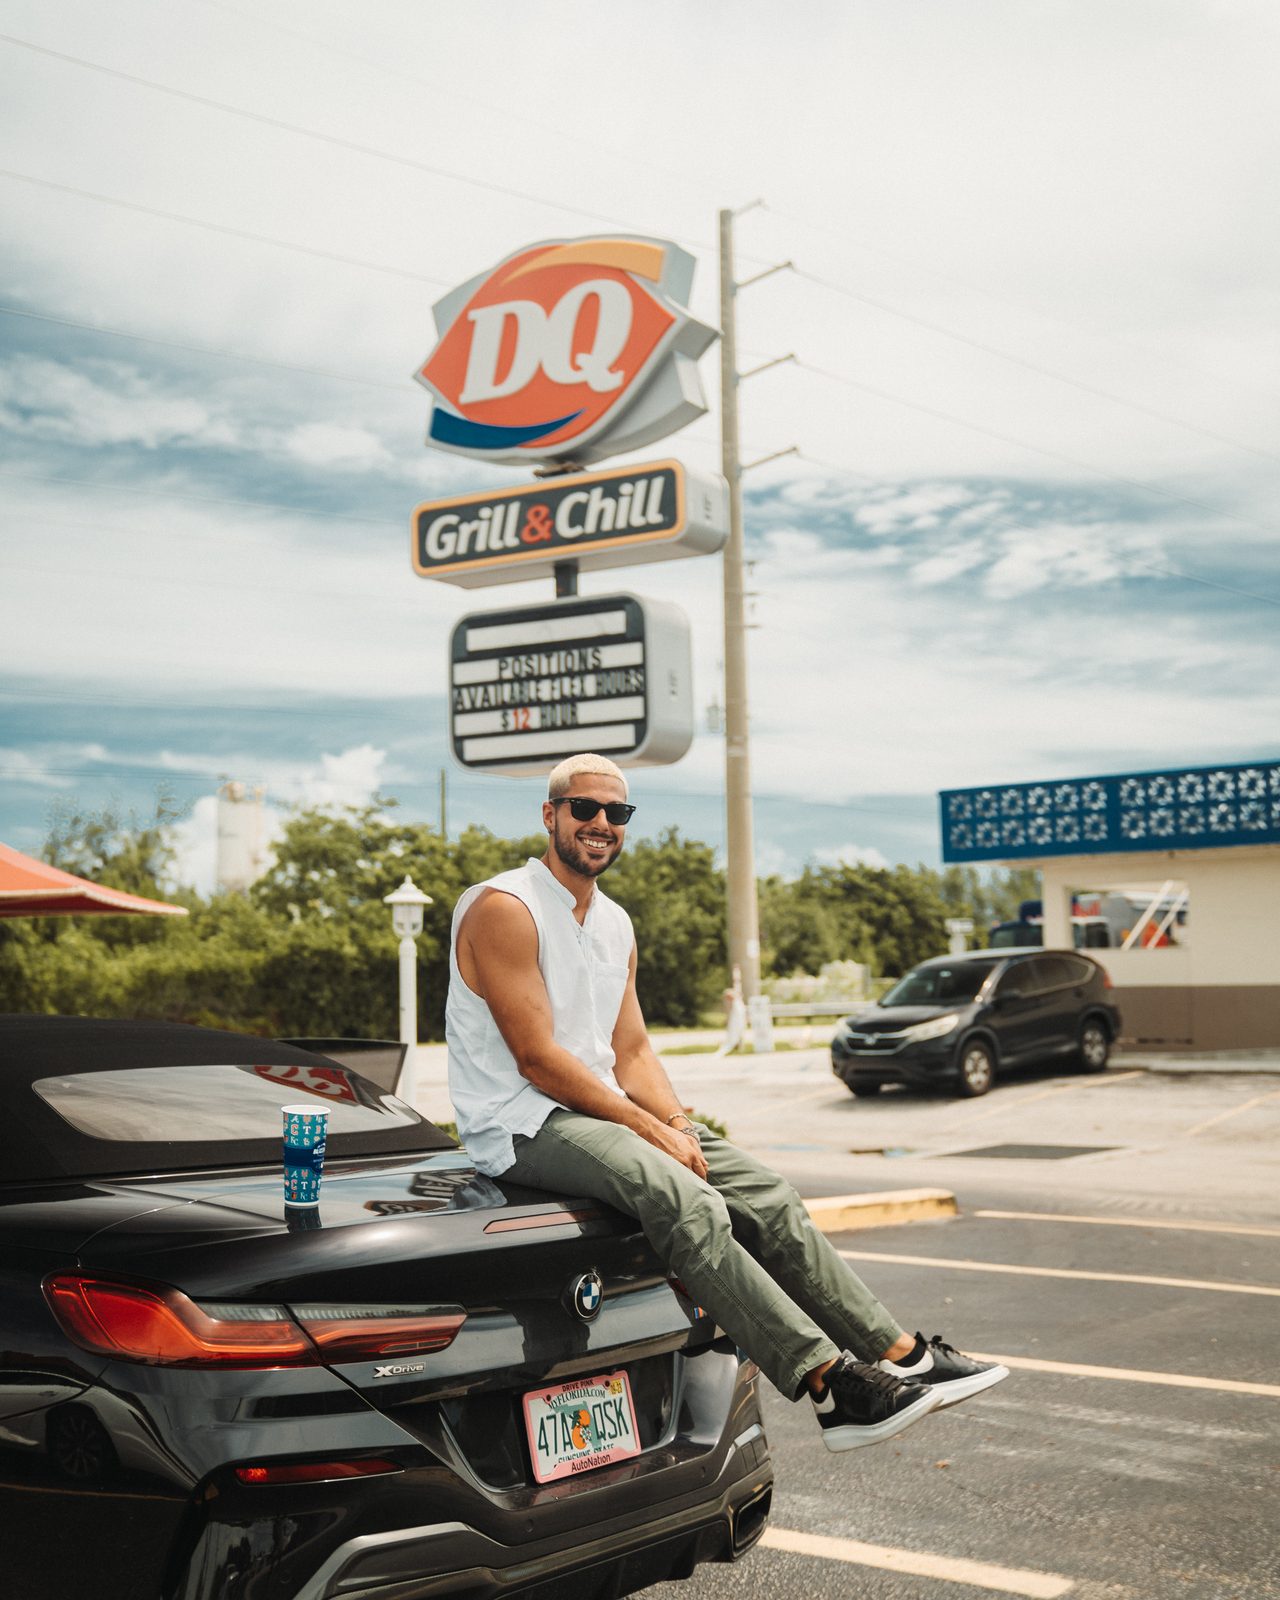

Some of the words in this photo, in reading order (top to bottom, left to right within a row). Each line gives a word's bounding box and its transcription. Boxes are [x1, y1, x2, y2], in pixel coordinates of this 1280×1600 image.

[458, 278, 634, 405] DQ
[425, 501, 521, 560] Grill
[520, 504, 554, 544] &
[555, 476, 666, 539] Chill
[500, 648, 602, 679] POSITIONS
[562, 1382, 580, 1393] DRIVE
[580, 1379, 594, 1389] PINK
[538, 1411, 574, 1457] 47A
[592, 1397, 629, 1441] QSK
[571, 1454, 611, 1473] AutoNation
